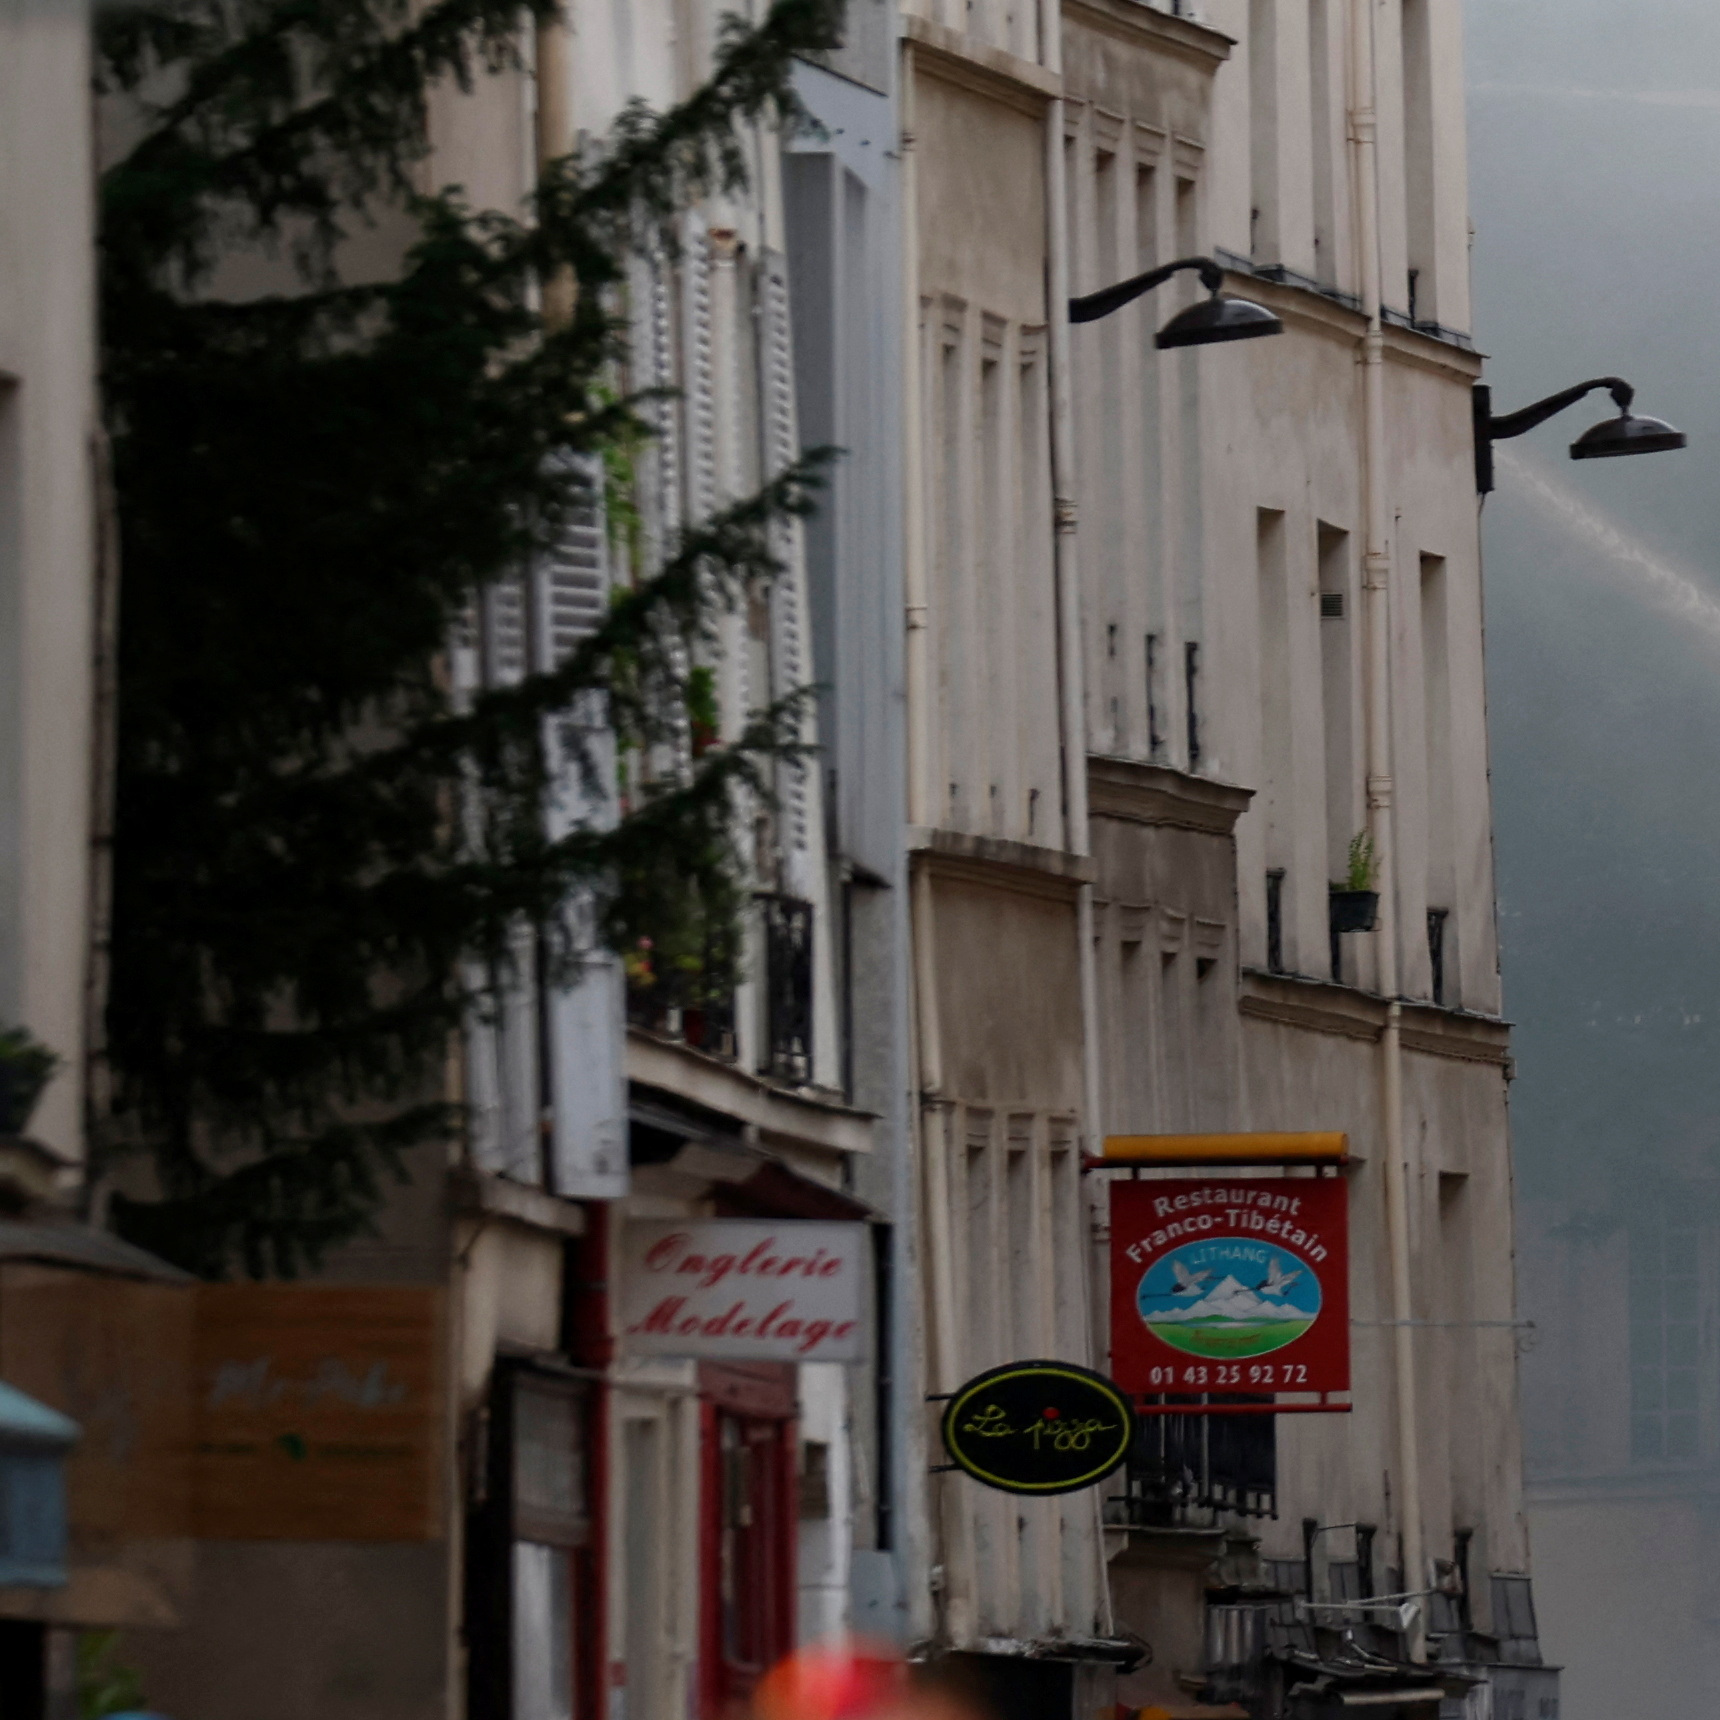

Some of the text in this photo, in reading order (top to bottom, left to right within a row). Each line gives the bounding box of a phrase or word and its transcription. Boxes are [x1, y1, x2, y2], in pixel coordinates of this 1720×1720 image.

[1152, 1187, 1302, 1217] Restaurant
[644, 1233, 842, 1289] Onglerie
[1126, 1208, 1328, 1263] Franco-Tibétain
[626, 1295, 858, 1352] Modelage
[1149, 1364, 1308, 1386] 01 43 25 92 72
[962, 1403, 1119, 1452] La pizza
